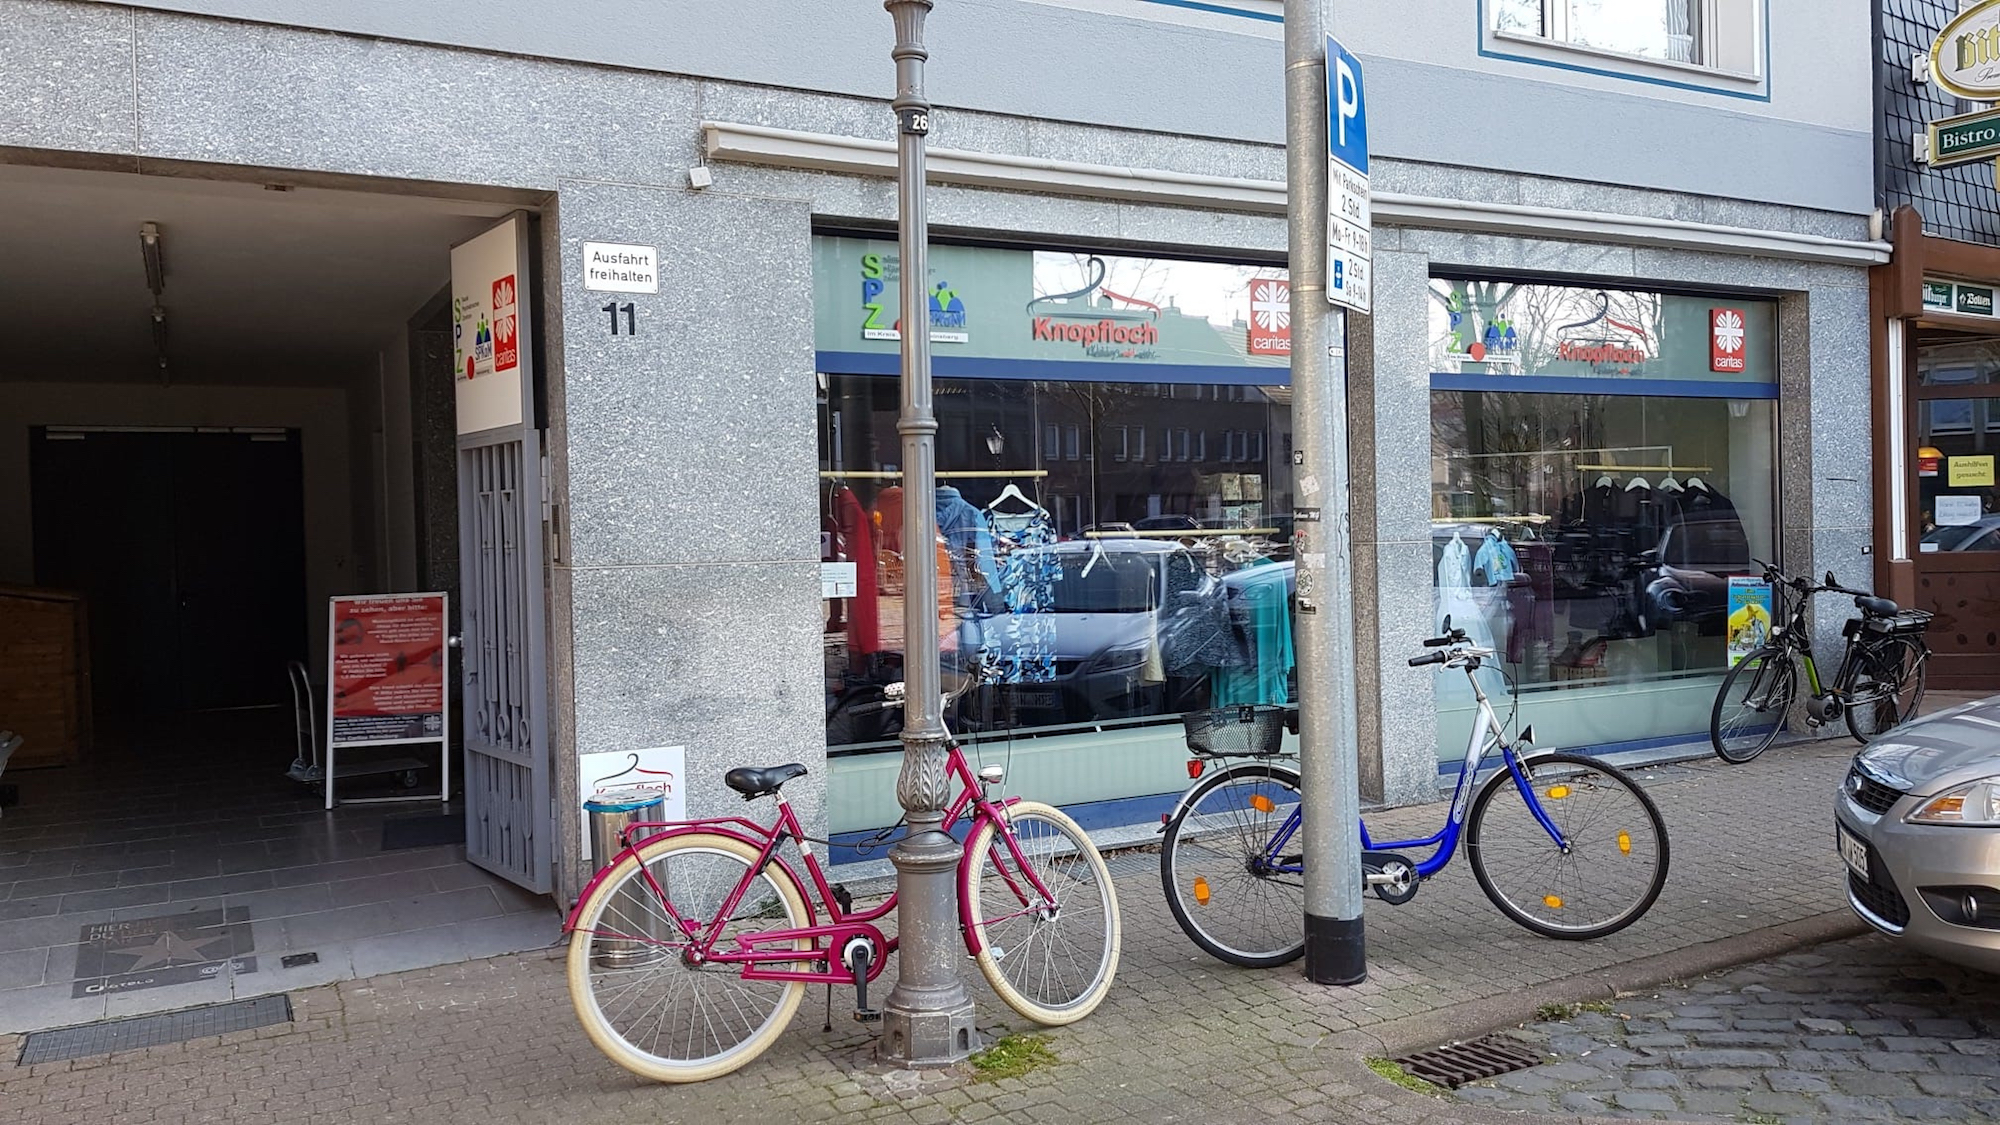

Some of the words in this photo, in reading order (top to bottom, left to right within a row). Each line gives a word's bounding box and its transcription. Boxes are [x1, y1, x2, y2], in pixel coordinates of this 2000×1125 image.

[1336, 56, 1358, 147] P
[912, 114, 928, 130] 26
[1942, 128, 1996, 149] Bistro
[1343, 173, 1367, 202] Parkschein
[1342, 194, 1346, 212] 2
[1348, 198, 1361, 220] Std.
[592, 251, 649, 266] Ausfahrt
[1348, 258, 1353, 276] 2
[590, 268, 652, 283] freihalten
[602, 302, 635, 336] 11
[1033, 317, 1159, 348] Knopfloch
[1253, 336, 1291, 350] caritas
[495, 347, 516, 367] caritas
[1559, 341, 1645, 365] Knopfloch
[1715, 356, 1743, 369] caritas
[361, 606, 387, 614] sehen,
[91, 922, 130, 933] HIER
[90, 932, 114, 942] DU
